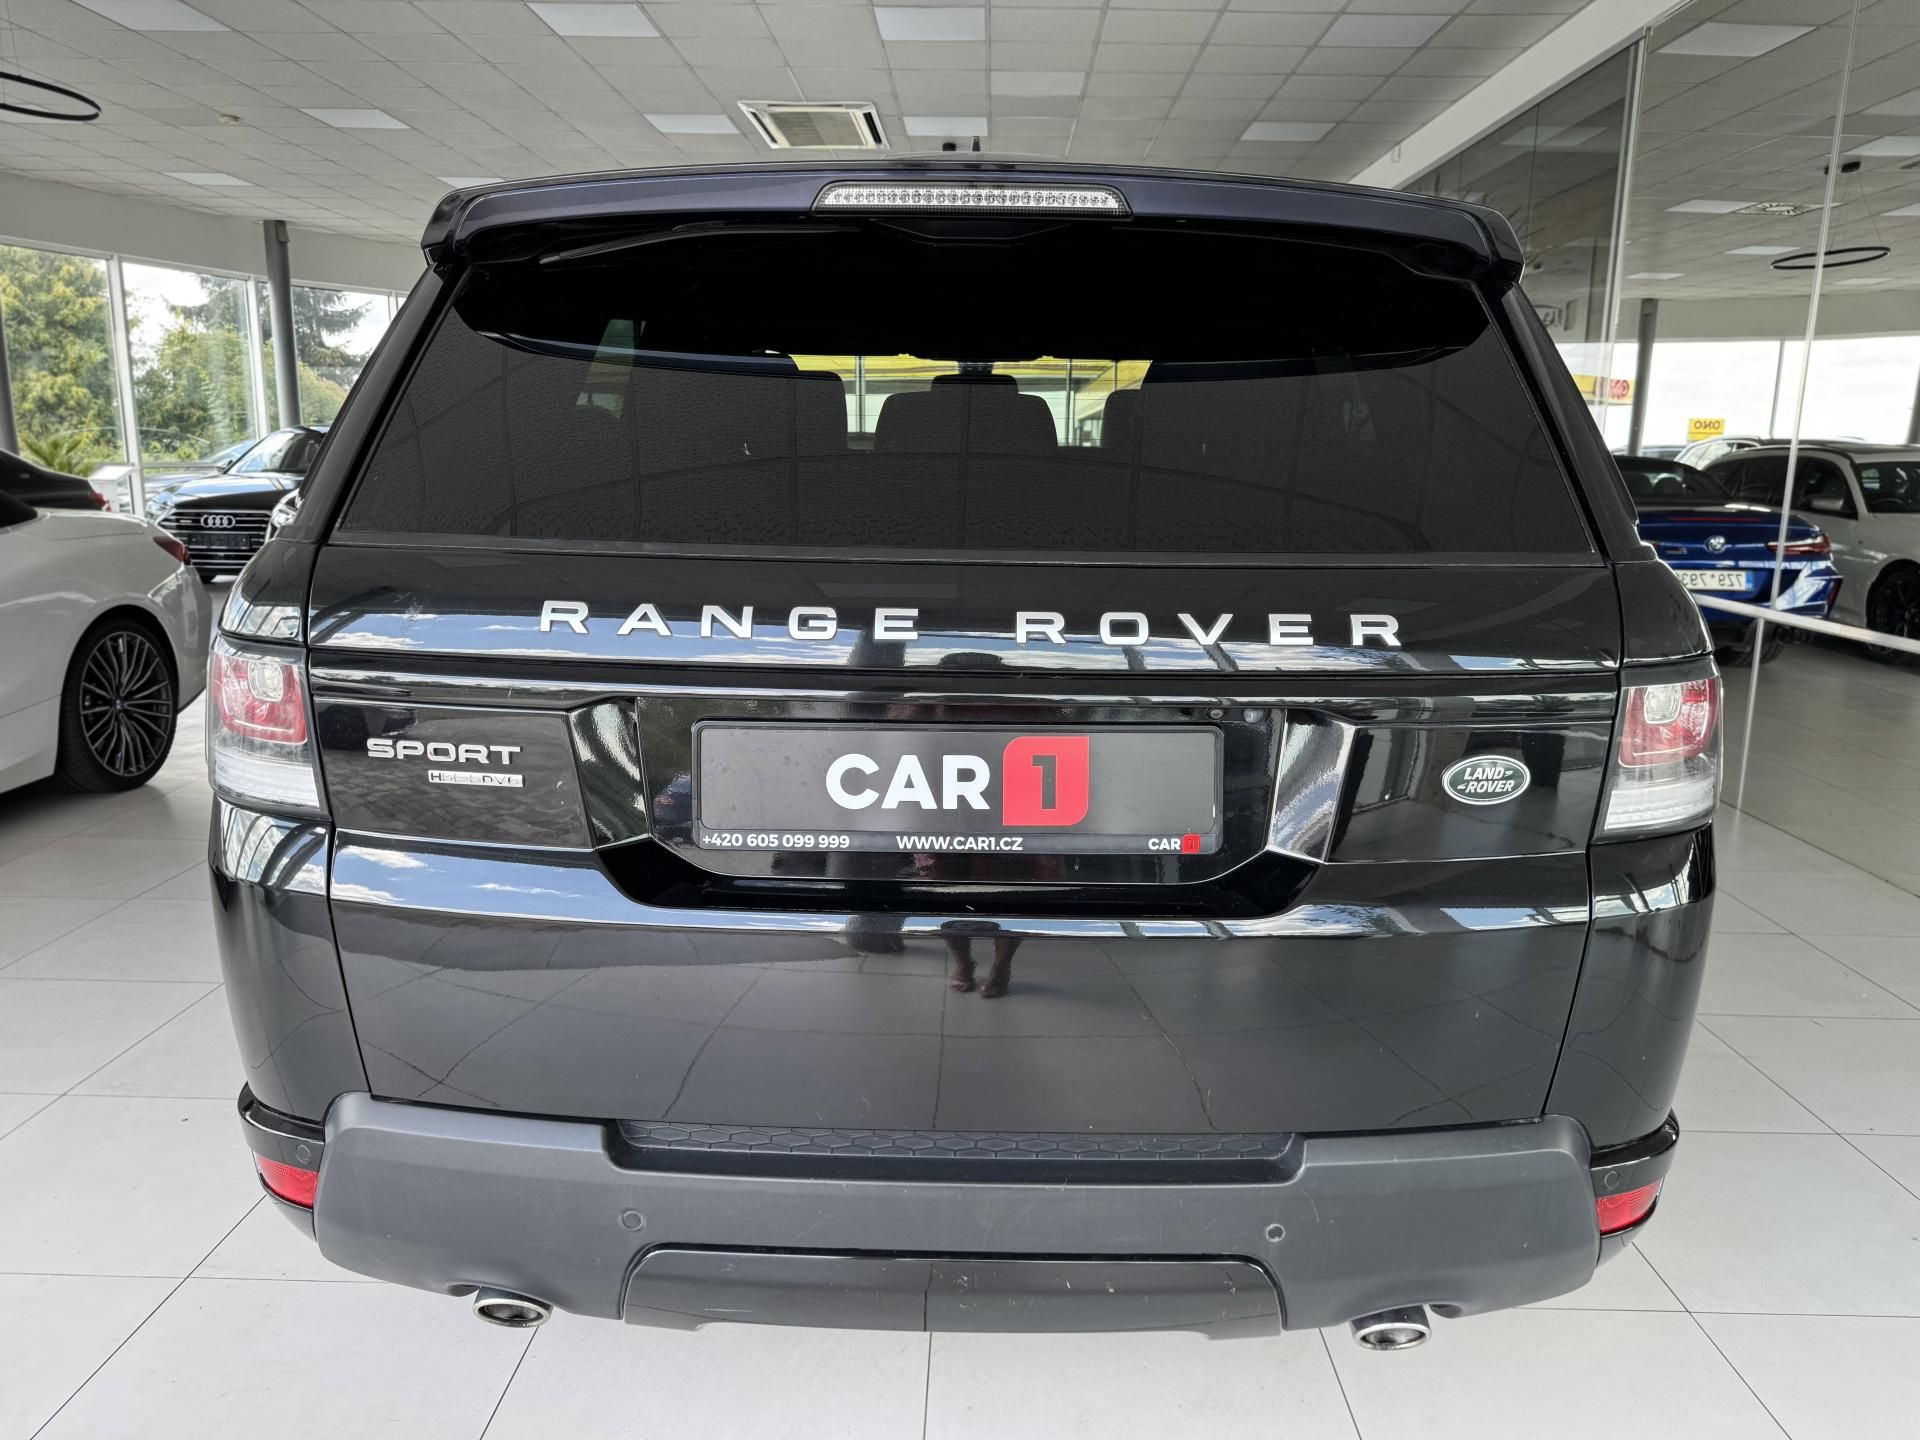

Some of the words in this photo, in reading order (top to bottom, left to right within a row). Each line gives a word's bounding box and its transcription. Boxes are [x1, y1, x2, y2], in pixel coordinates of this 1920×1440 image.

[539, 600, 919, 640] RANGE
[1016, 611, 1401, 646] ROVER
[366, 738, 521, 765] SPORT
[1463, 767, 1505, 780] LAND
[1465, 780, 1515, 793] ROVER
[702, 833, 743, 847] +420
[747, 834, 779, 847] 605
[782, 834, 815, 848] 099
[818, 835, 850, 848] 999
[895, 835, 1024, 851] WWW.CAR1.CZ
